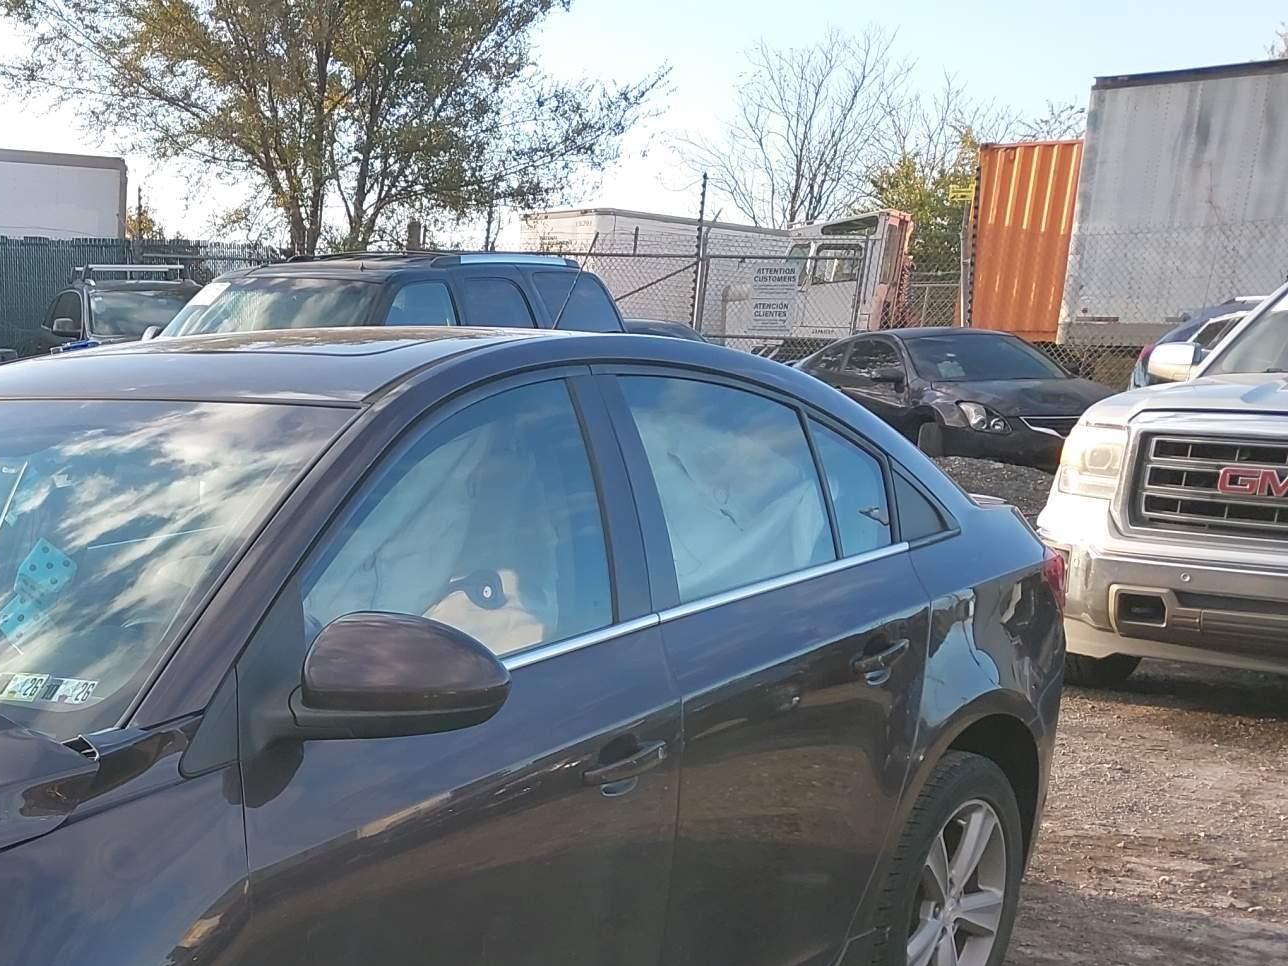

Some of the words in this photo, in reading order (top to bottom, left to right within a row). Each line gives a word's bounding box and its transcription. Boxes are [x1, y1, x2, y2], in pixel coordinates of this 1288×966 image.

[756, 267, 796, 275] ATTENTION
[753, 275, 797, 283] CUSTOMERS
[753, 301, 789, 310] ATENCIÓN
[753, 310, 787, 318] CLIENTES
[22, 677, 44, 697] 26
[74, 682, 96, 702] 26
